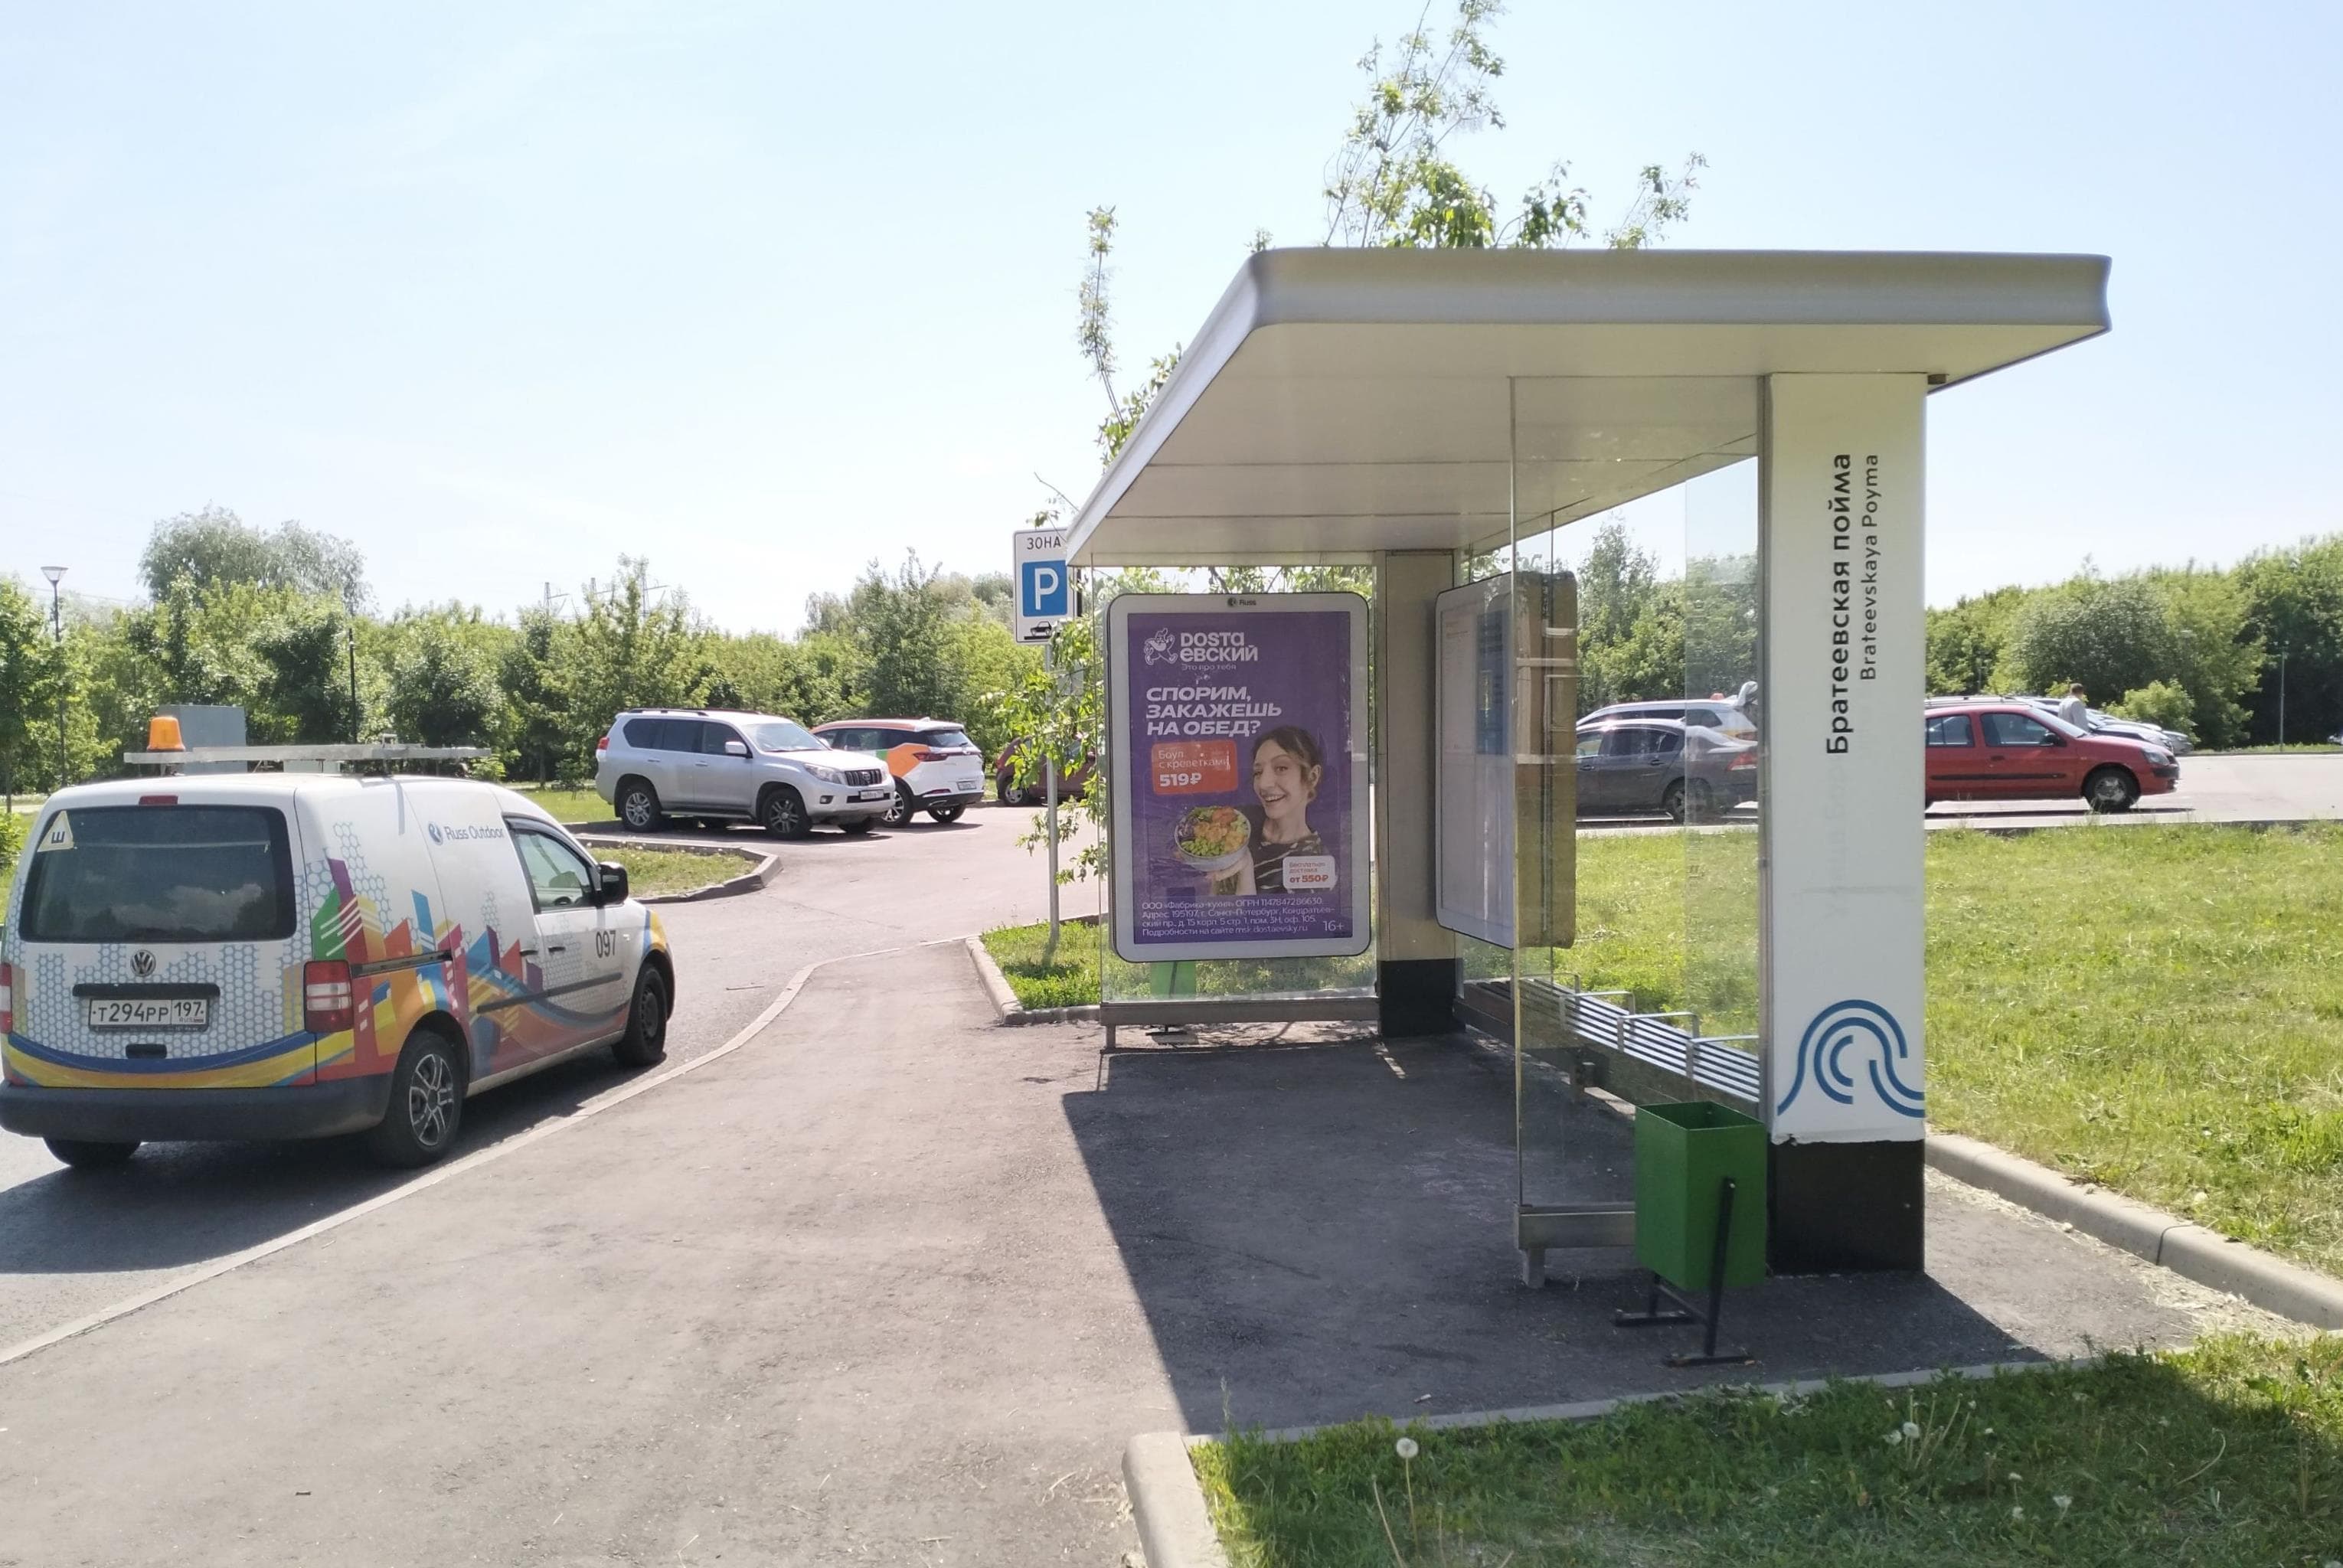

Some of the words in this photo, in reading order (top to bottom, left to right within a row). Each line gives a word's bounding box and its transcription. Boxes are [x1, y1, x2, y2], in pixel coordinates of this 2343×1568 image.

[1861, 454, 1882, 528] Poyma
[1828, 453, 1851, 550] пойма
[1027, 537, 1061, 550] ЗОНА
[1860, 534, 1882, 680] Brateevskaya
[1826, 561, 1854, 754] Братеевская
[1145, 686, 1251, 702] СПОРИМ,
[1145, 703, 1282, 719] ЗАКАЖЕШЬ
[1147, 720, 1180, 735] НА
[1183, 720, 1261, 737] ОБЕД?
[1158, 750, 1184, 760] Боул
[1167, 758, 1229, 769] креветками
[1159, 772, 1202, 787] 519₽
[51, 831, 65, 844] Ш
[444, 826, 469, 840] Russ
[469, 825, 505, 839] Outdoor
[1235, 899, 1260, 907] ОГРН
[1142, 928, 1198, 937] Подробности
[1322, 920, 1345, 931] 16+
[596, 929, 616, 959] 097
[98, 1002, 168, 1022] Т294РР
[174, 1001, 202, 1017] 197
